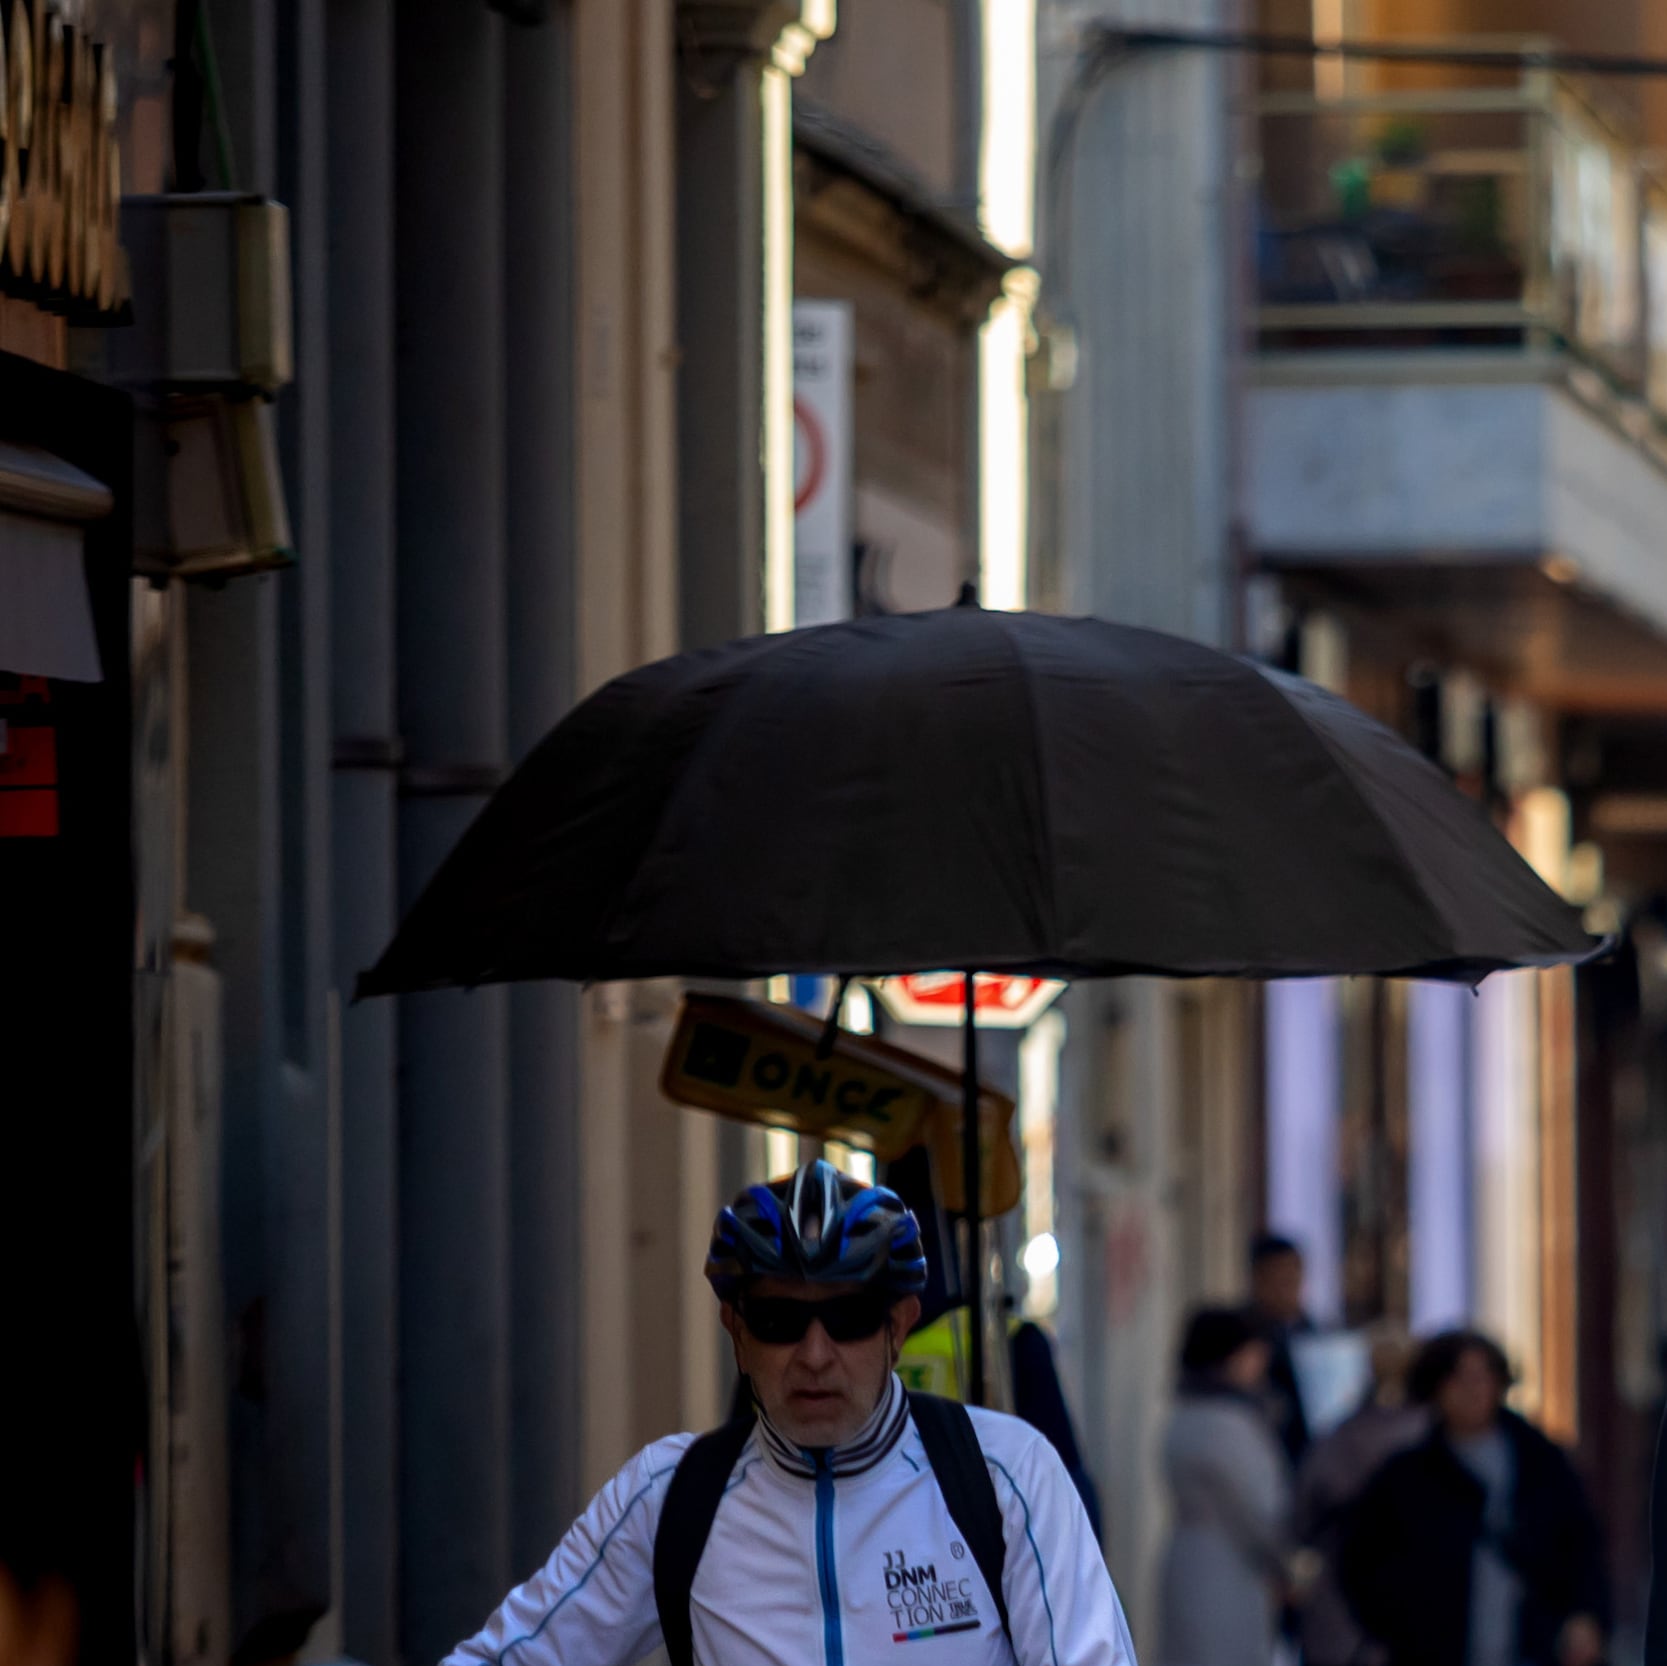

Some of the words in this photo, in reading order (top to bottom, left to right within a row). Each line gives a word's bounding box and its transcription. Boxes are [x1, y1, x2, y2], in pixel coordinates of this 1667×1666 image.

[753, 1053, 903, 1123] ONCE
[884, 1564, 937, 1590] DNM
[887, 1578, 971, 1609] CONNEC
[890, 1604, 944, 1629] TION
